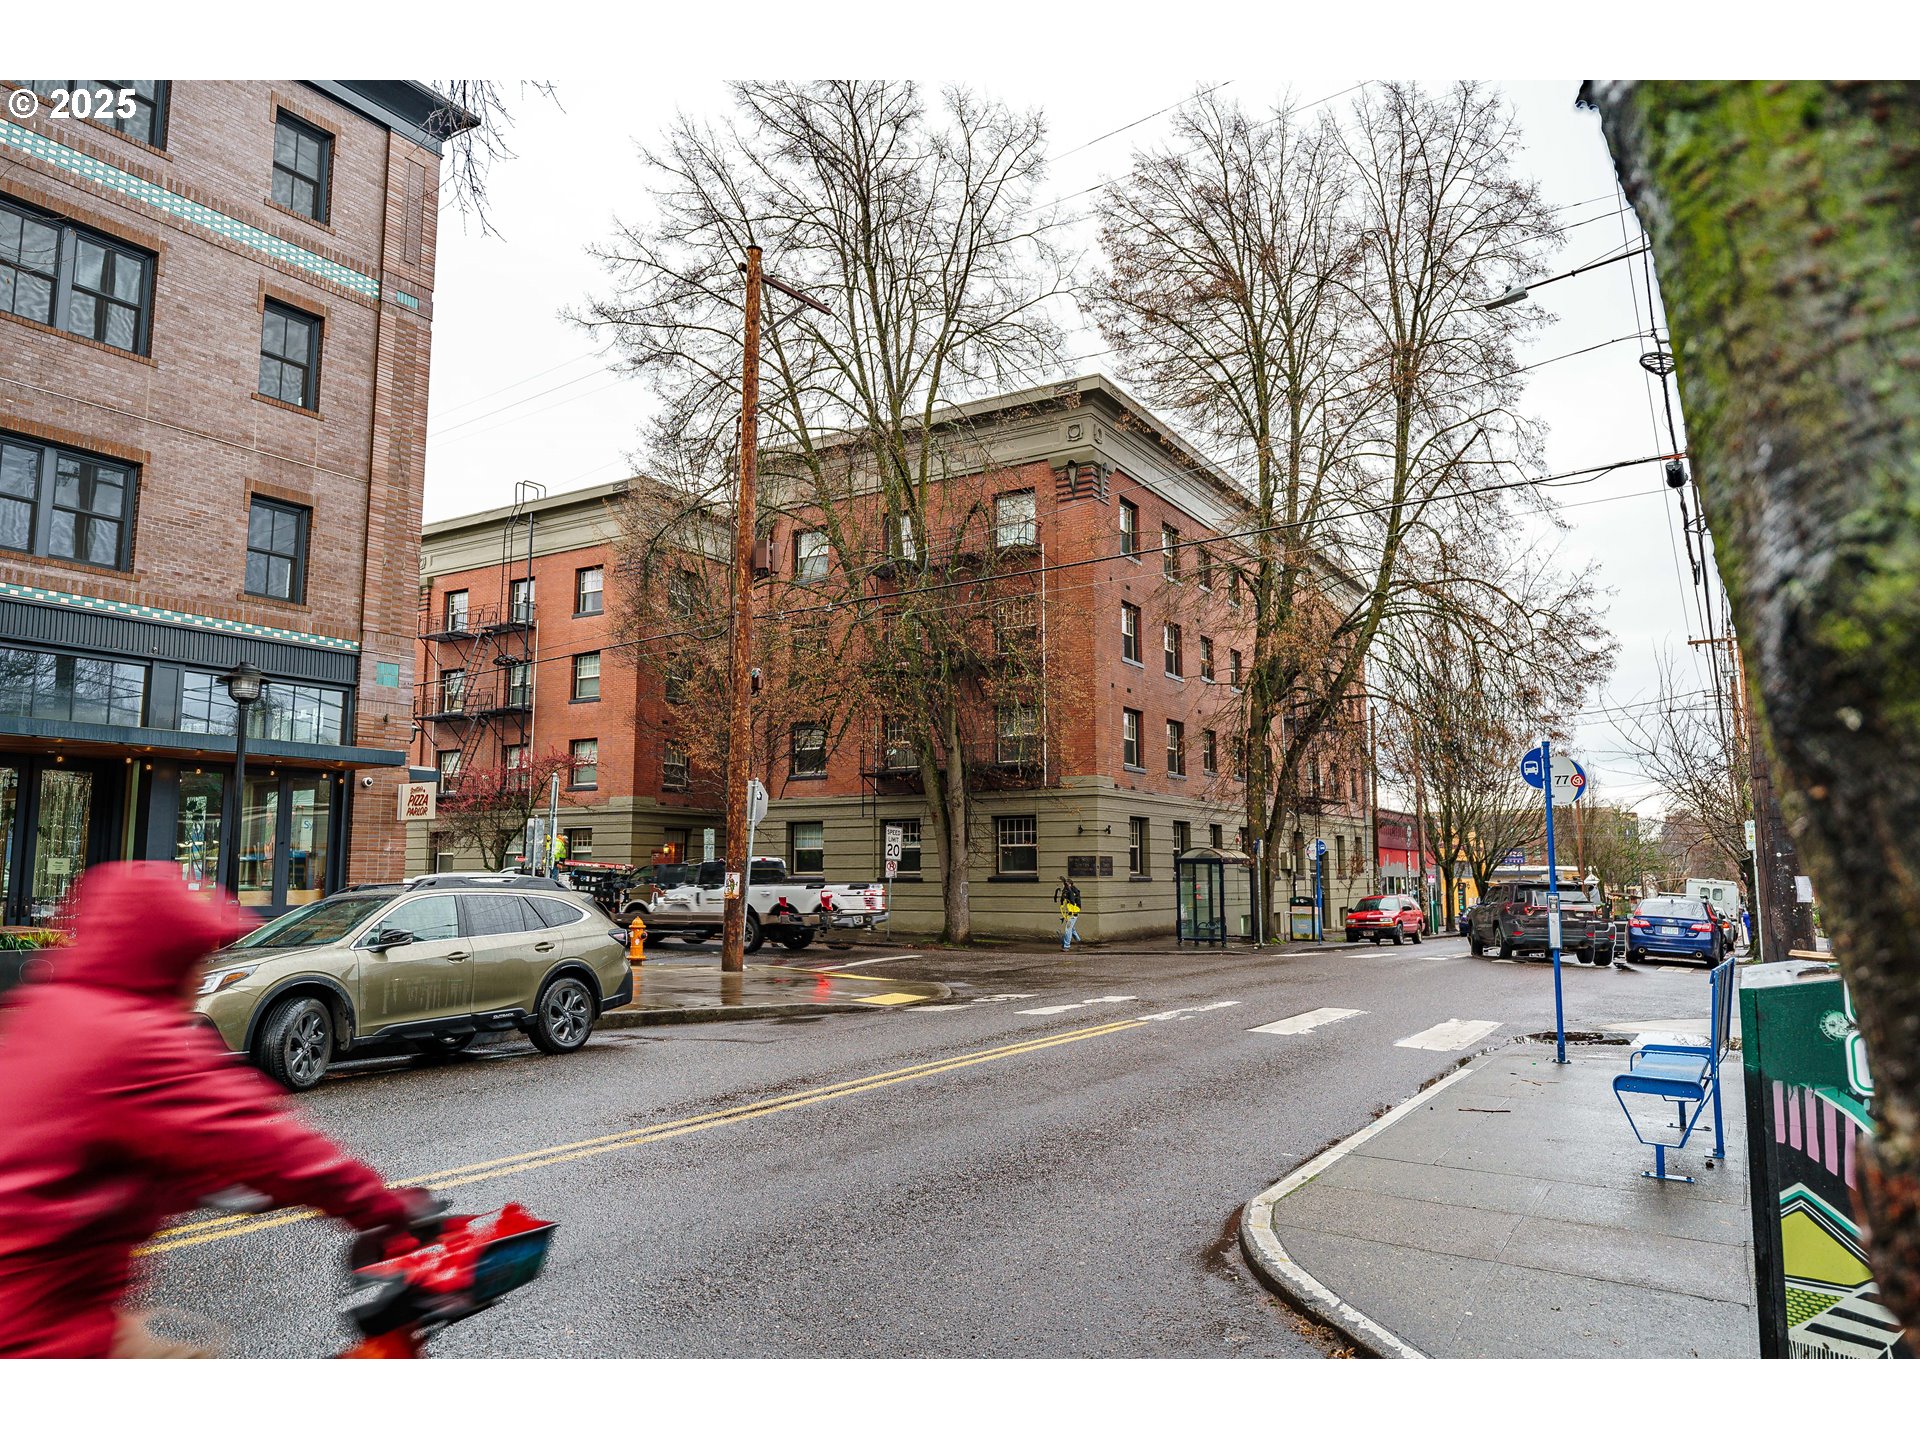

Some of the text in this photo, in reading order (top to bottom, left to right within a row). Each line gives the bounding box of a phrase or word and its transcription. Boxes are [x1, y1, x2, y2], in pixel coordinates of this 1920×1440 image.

[1554, 775, 1570, 785] 77
[407, 794, 429, 807] PIZZA
[406, 806, 429, 817] PARLOR
[887, 843, 900, 857] 20
